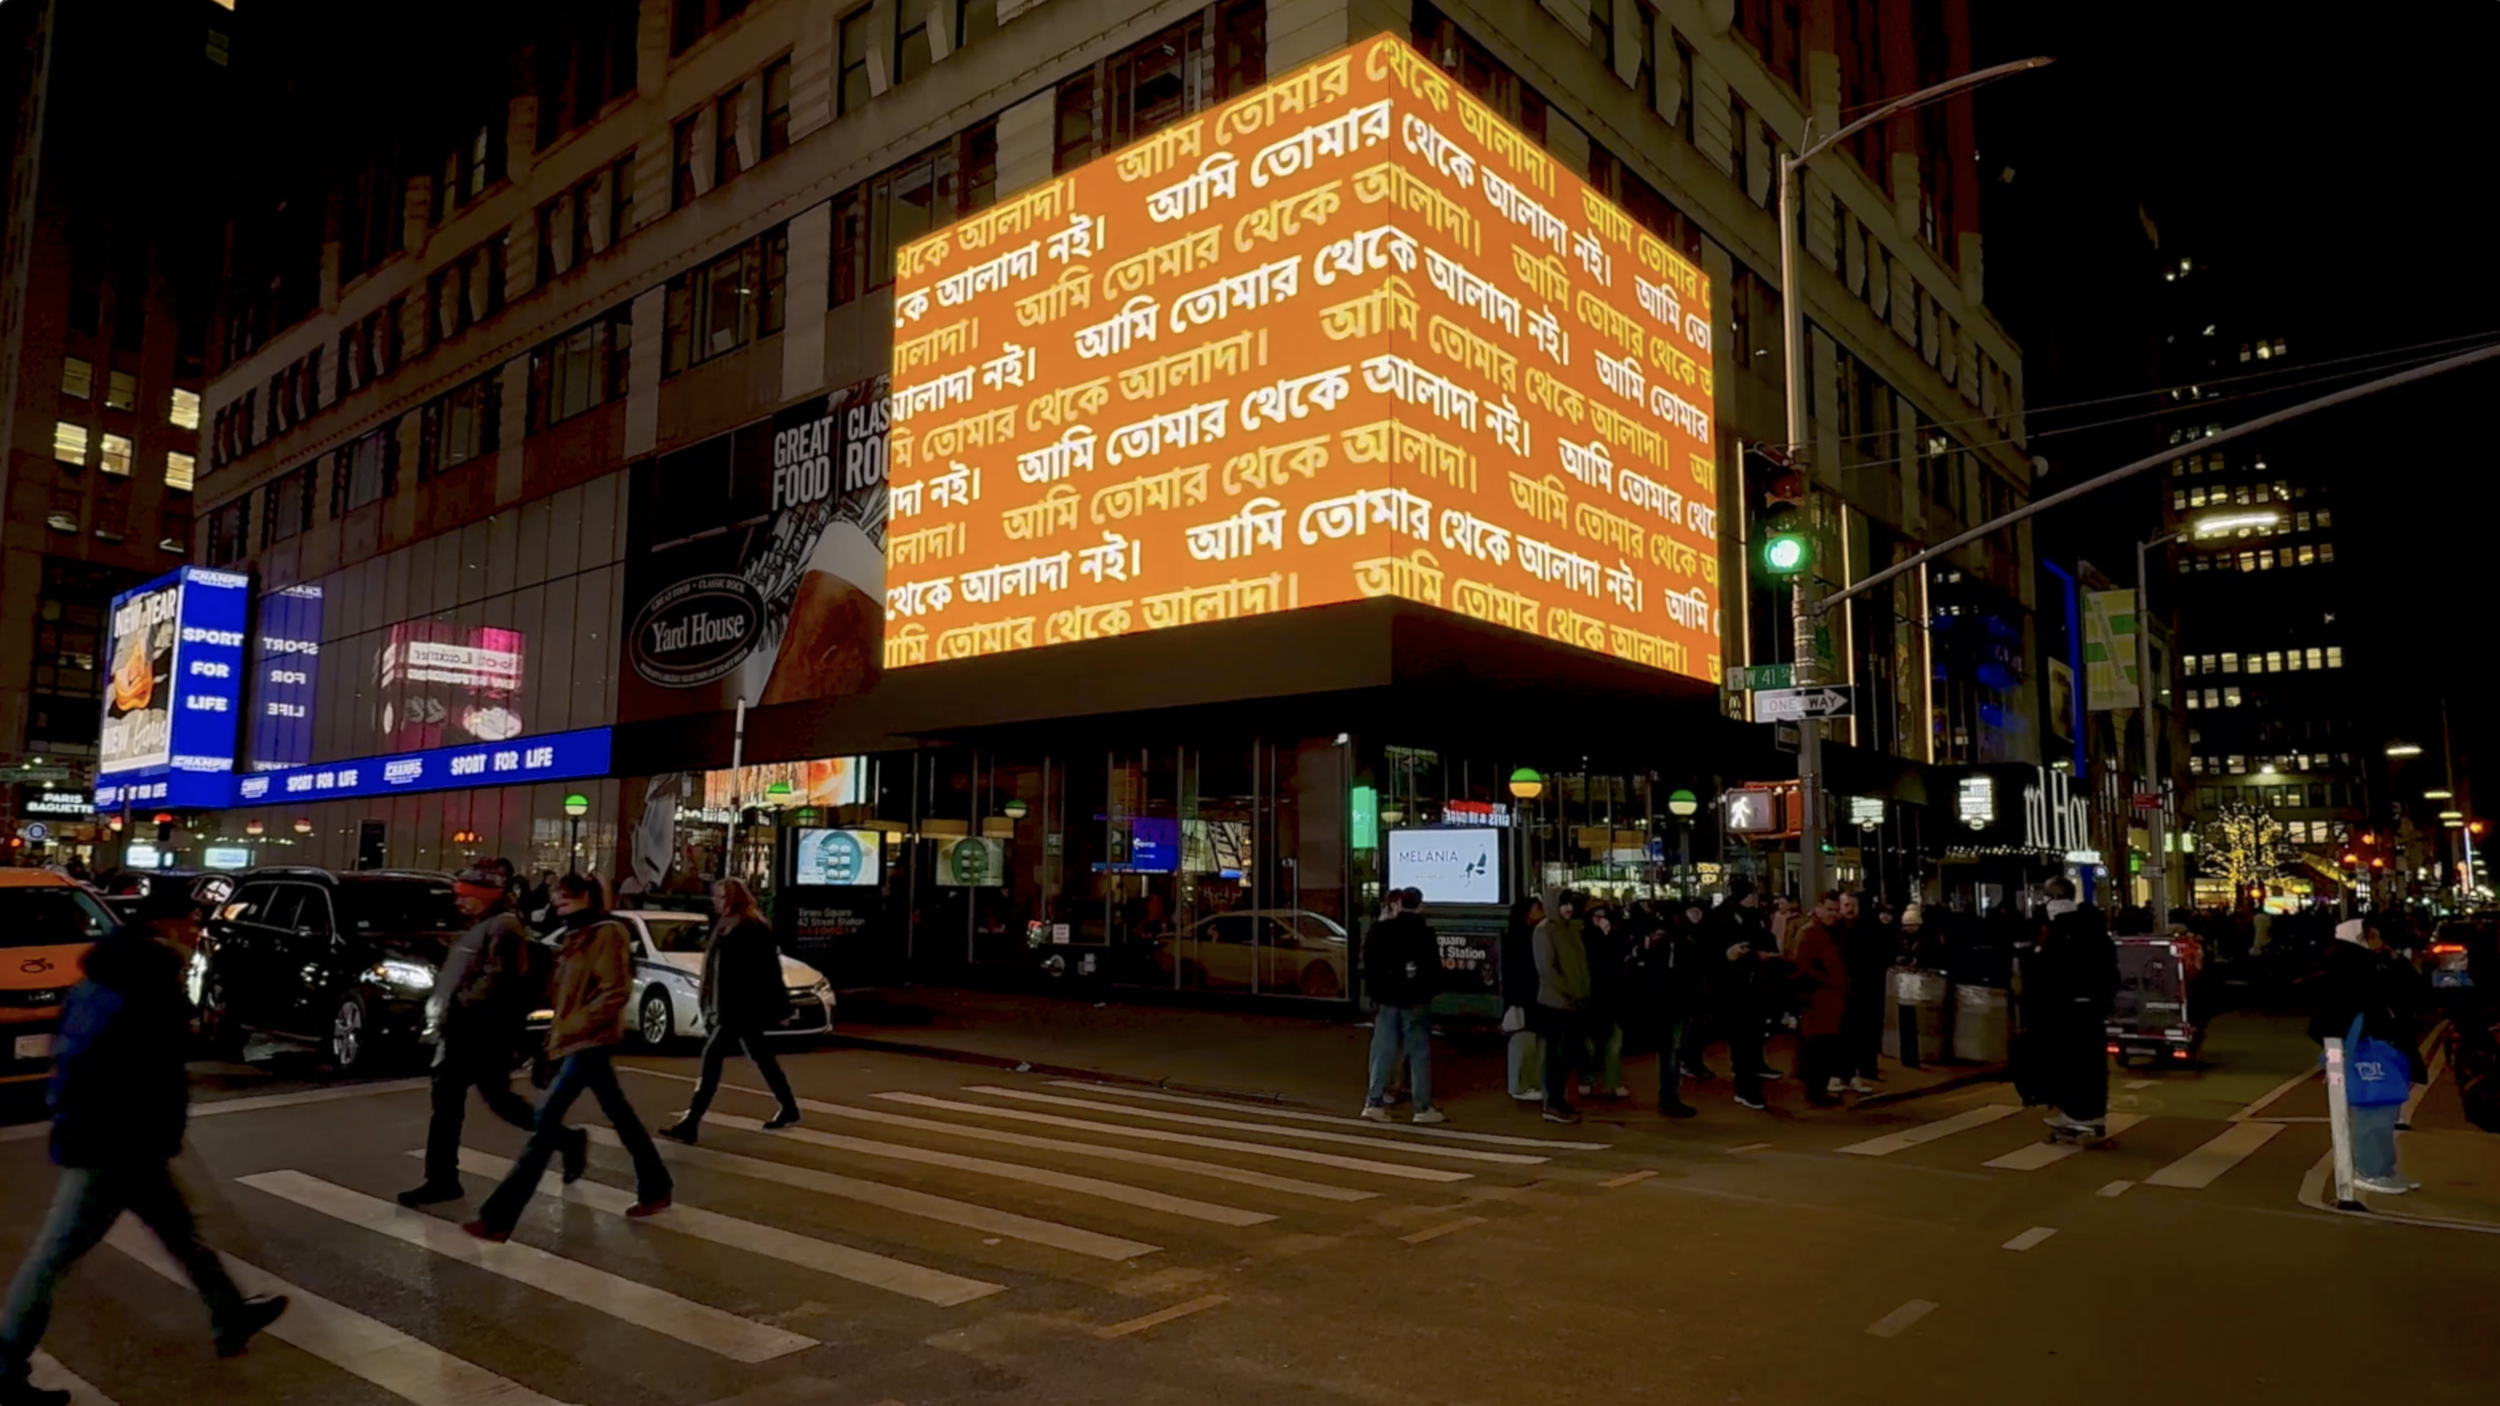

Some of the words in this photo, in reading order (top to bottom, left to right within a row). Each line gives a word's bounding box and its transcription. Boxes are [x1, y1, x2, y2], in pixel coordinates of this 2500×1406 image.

[1365, 38, 1450, 112] থেকে
[1455, 90, 1555, 197] আলাদা।
[933, 238, 1041, 307] আলাদা
[1045, 213, 1105, 265] নই।
[1144, 152, 1240, 223] আমি
[1249, 97, 1393, 188] তোমার
[1401, 111, 1476, 189] থেকে
[1479, 164, 1568, 258] আলাদা
[1571, 228, 1611, 287] নই।
[1633, 274, 1681, 333] আমি
[1013, 263, 1094, 327] আমি
[1102, 223, 1223, 301] তোমার
[1233, 178, 1343, 253] থেকে
[1351, 160, 1480, 256] আলাদা।
[1510, 243, 1570, 311] আমি
[1575, 289, 1645, 358] তোমার
[1649, 335, 1696, 386] থেকে
[980, 340, 1036, 392] নই।
[1072, 293, 1161, 359] আমি
[1168, 253, 1302, 334] তোমার
[1312, 223, 1419, 286] থেকে
[1422, 245, 1522, 338] আলাদা
[1525, 303, 1569, 366] নই।
[1593, 348, 1645, 408] আমি
[1649, 384, 1710, 444] তোমার
[890, 425, 915, 468] মি
[921, 403, 1018, 462] তোমার
[1025, 375, 1111, 432] থেকে
[1117, 327, 1268, 401] আলাদা।
[1318, 274, 1420, 341] আমি
[1428, 313, 1518, 393] তোমার
[1524, 366, 1585, 424] থেকে
[1588, 398, 1669, 470] আলাদা।
[847, 399, 890, 441] CLAS
[927, 458, 981, 508] নই।
[1015, 422, 1096, 484] আমি
[1104, 397, 1230, 466] তোমার
[1239, 363, 1352, 432] থেকে
[1359, 352, 1479, 433] আলাদা
[1482, 392, 1530, 458] নই।
[1556, 436, 1614, 494] আমি
[1617, 467, 1683, 525] তোমার
[774, 416, 833, 468] GREAT
[845, 434, 889, 491] RO
[772, 455, 830, 511] FOOD
[886, 520, 966, 570] লাদা।
[1000, 482, 1081, 540] আমি
[1089, 462, 1212, 525] তোমার
[1221, 433, 1331, 496] থেকে
[1339, 417, 1477, 494] আলাদা।
[1507, 470, 1569, 530] আমি
[1574, 501, 1645, 559] তোমার
[1649, 532, 1697, 577] থেকে
[958, 548, 1072, 604] আলাদা
[1077, 528, 1141, 584] নই।
[1183, 495, 1288, 561] আমি
[1296, 486, 1433, 546] তোমার
[1439, 507, 1512, 566] থেকে
[1514, 533, 1602, 599] আলাদা
[1603, 557, 1643, 613] নই।
[1663, 585, 1709, 634] আমি
[145, 588, 177, 625] YEAR
[1043, 598, 1134, 645] থেকে
[1139, 570, 1298, 629] আলাদা।
[1352, 547, 1444, 607] আমি
[1546, 606, 1606, 651] থেকে
[182, 627, 244, 647] SPORT
[651, 616, 689, 654] Yard
[690, 612, 745, 647] House
[190, 660, 230, 679] FOR
[1745, 669, 1756, 687] W
[1761, 668, 1776, 686] 41
[186, 695, 228, 712] LIFE
[1769, 698, 1797, 711] ONE
[1808, 695, 1838, 708] WAY
[338, 770, 358, 787] LIFE
[451, 754, 487, 776] SPORT
[494, 751, 519, 771] FOR
[526, 747, 553, 768] LIFE
[26, 801, 94, 814] BAGUETTE
[42, 792, 84, 804] PARIS
[1399, 850, 1459, 863] MELANIA
[1436, 935, 1467, 947] quare
[1447, 946, 1486, 960] Station
